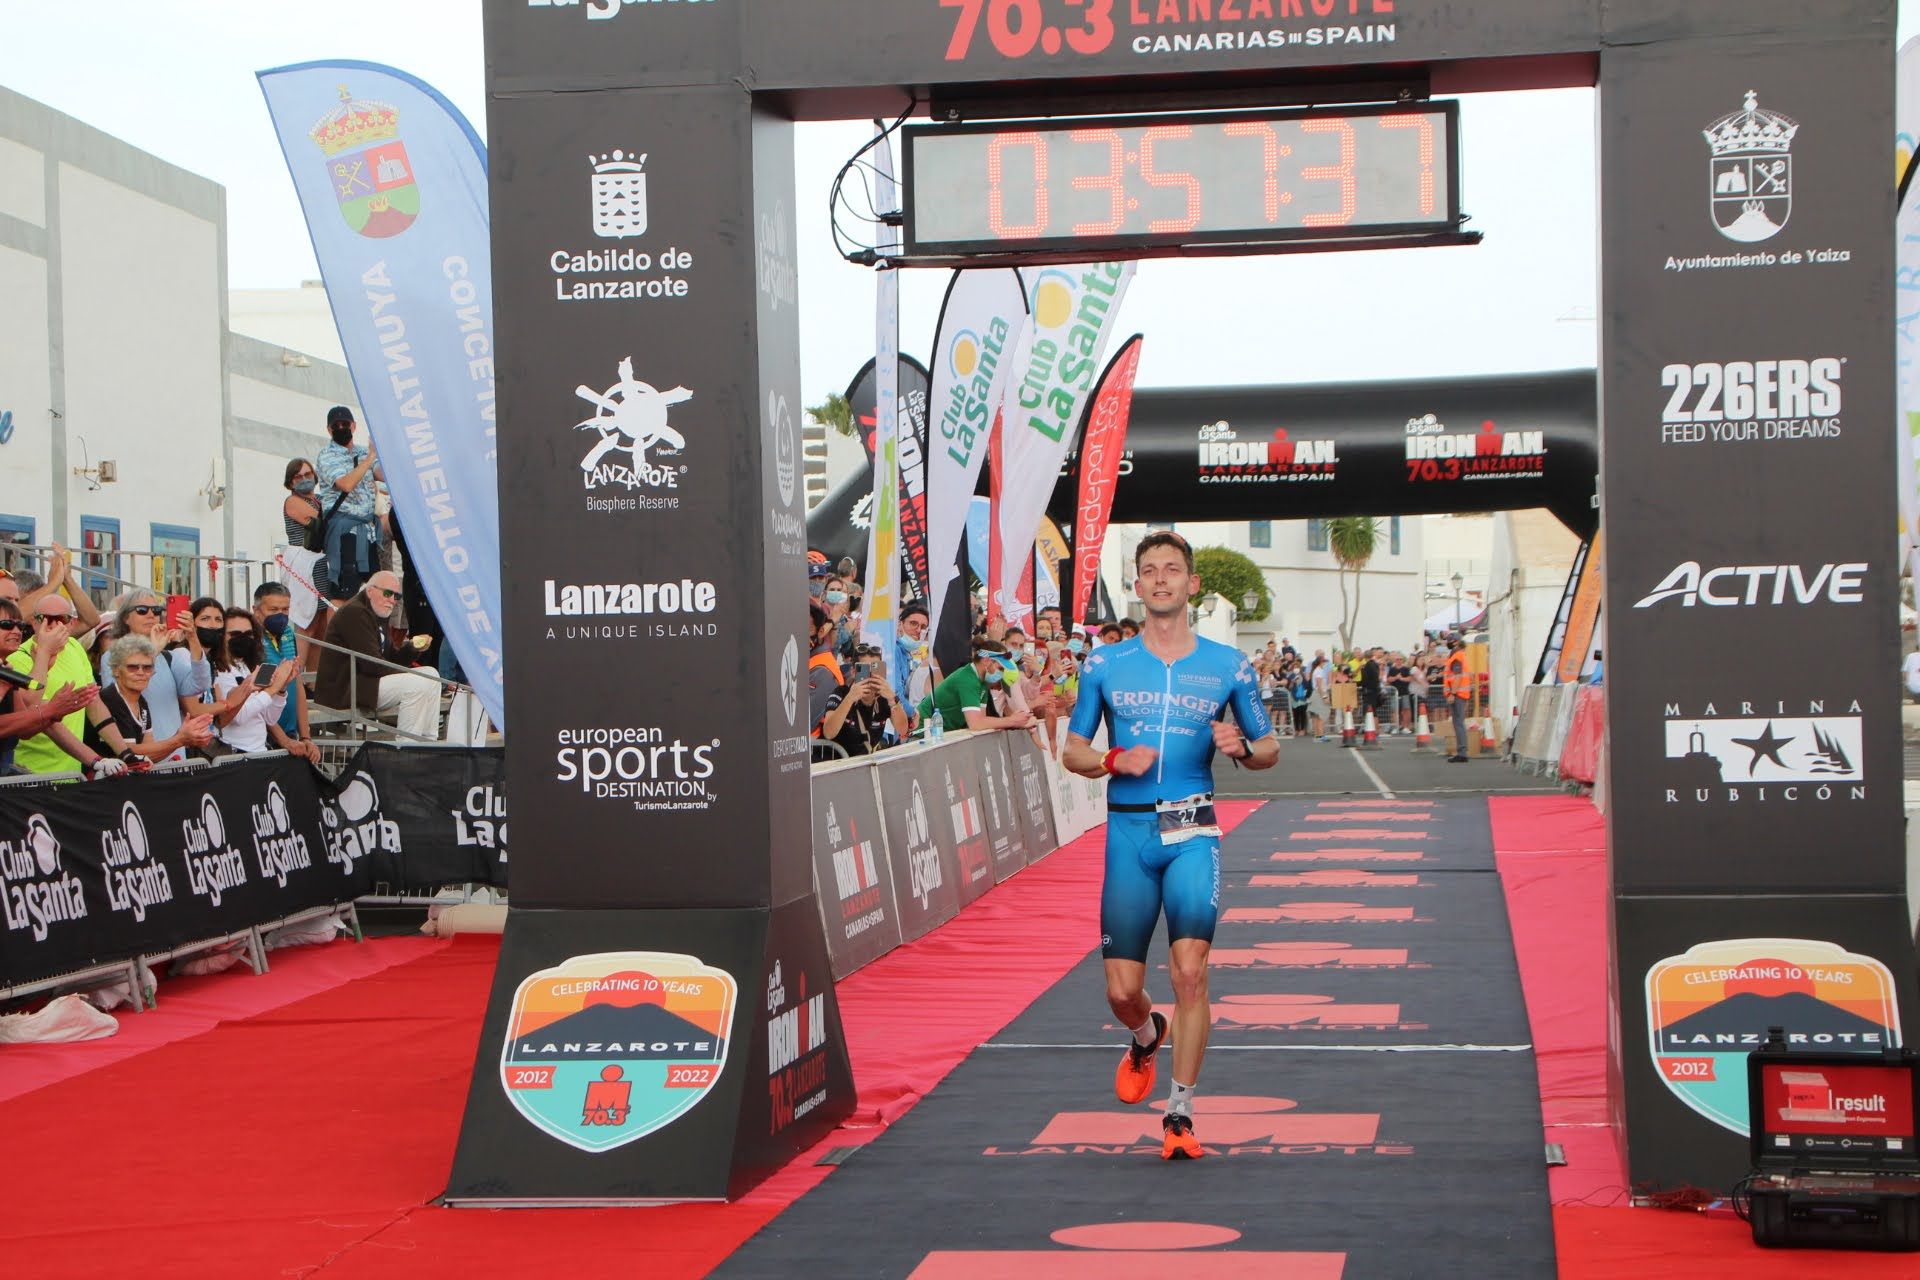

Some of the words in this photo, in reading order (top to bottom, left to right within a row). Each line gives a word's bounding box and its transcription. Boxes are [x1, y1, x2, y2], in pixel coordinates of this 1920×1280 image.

[939, 0, 1115, 60] 70.3
[1305, 23, 1396, 46] SPAIN
[550, 249, 651, 273] Cabildo
[659, 247, 693, 270] de
[1664, 250, 1776, 272] Ayuntamiento
[1781, 248, 1802, 264] de
[1805, 247, 1851, 262] Yaiza
[556, 275, 689, 301] Lanzarote
[1018, 337, 1058, 411] Club
[1661, 358, 1842, 422] 226ERS
[940, 382, 967, 441] Club
[1662, 421, 1706, 443] FEED
[1711, 420, 1760, 441] YOUR
[1764, 417, 1842, 439] DREAMS
[1199, 440, 1336, 467] IRONMAN
[1406, 431, 1544, 460] IRONMAN
[583, 462, 679, 491] LANZAROTE
[1199, 463, 1337, 475] LANZAROTE
[1289, 472, 1336, 482] SPAIN
[1406, 458, 1461, 482] 70.3
[1463, 456, 1544, 472] LANZAROTE
[586, 496, 636, 514] Biosphere
[639, 495, 680, 511] Reserve
[544, 578, 717, 616] Lanzarote
[1632, 560, 1869, 608] ACTIVE
[545, 626, 556, 640] A
[566, 625, 638, 640] UNIQUE
[648, 623, 718, 637] ISLAND
[1111, 690, 1220, 717] ERDINGER
[1247, 690, 1267, 732] FUSION
[1664, 699, 1863, 716] MARINA
[558, 726, 663, 751] european
[1143, 724, 1198, 737] CUBE
[556, 739, 715, 793] sports
[466, 785, 507, 817] Clu
[596, 780, 706, 798] DESTINATION
[707, 792, 718, 803] by
[1665, 783, 1865, 802] RUBICÓN
[251, 802, 276, 834] Club
[634, 800, 709, 811] TurismoLanzarote
[1178, 807, 1197, 823] 27
[101, 826, 131, 868] Club
[181, 818, 209, 852] Club
[0, 839, 35, 881] Club
[551, 979, 640, 997] CELEBRATING
[642, 978, 658, 991] 10
[661, 980, 703, 996] YEARS
[1684, 967, 1781, 985] CELEBRATING
[1784, 967, 1802, 980] 10
[1806, 968, 1854, 984] YEARS
[767, 992, 827, 1076] IRONMAN
[521, 1041, 710, 1054] LANZAROTE
[514, 1070, 549, 1084] 2012
[670, 1069, 709, 1084] 2022
[1671, 1062, 1709, 1076] 2012
[769, 1067, 794, 1137] 70.3
[1835, 1093, 1887, 1113] result
[580, 1109, 629, 1126] 70.3
